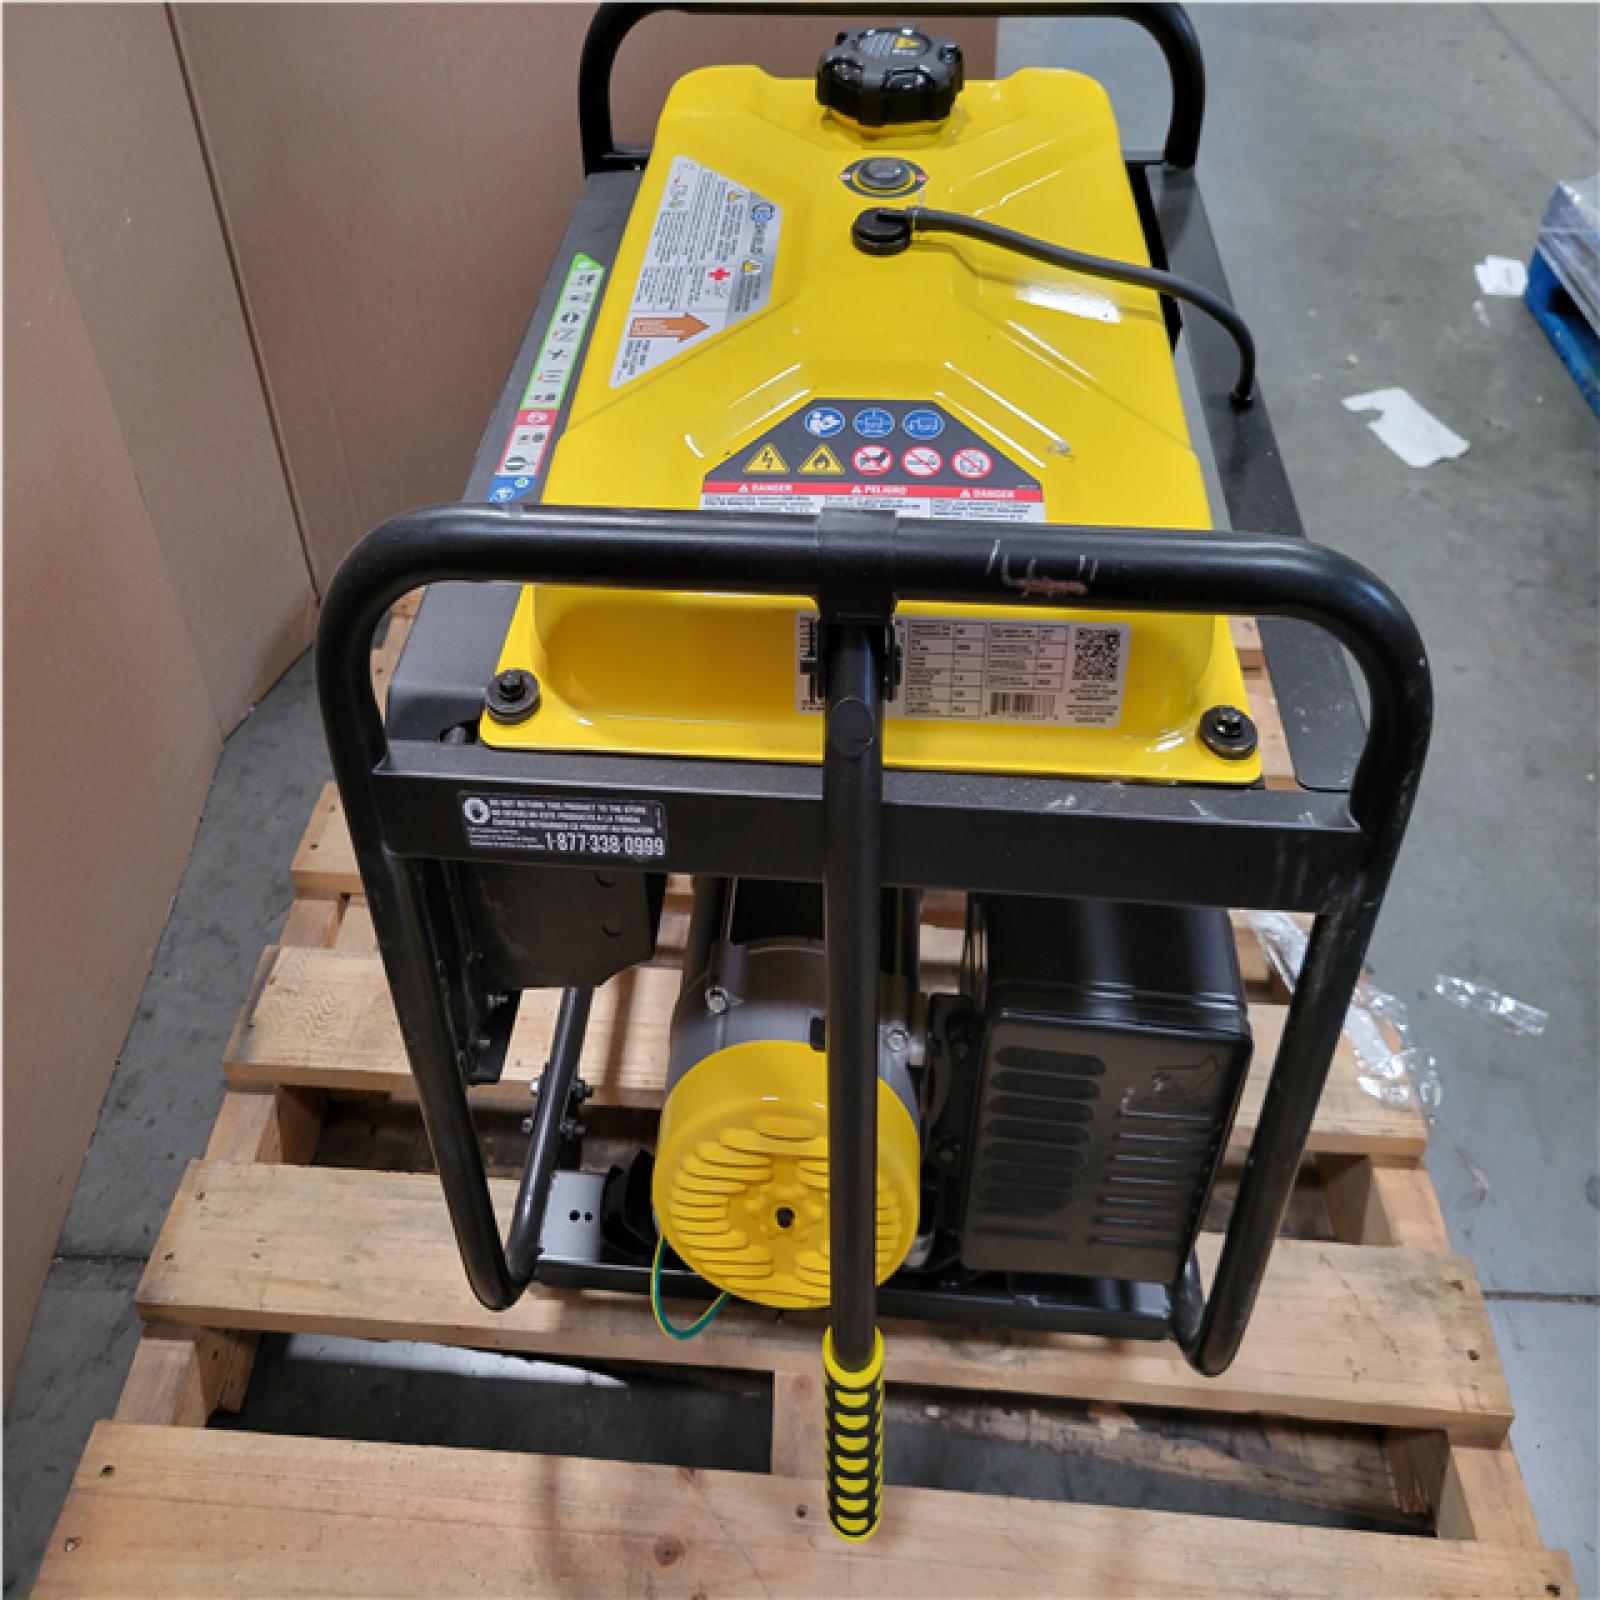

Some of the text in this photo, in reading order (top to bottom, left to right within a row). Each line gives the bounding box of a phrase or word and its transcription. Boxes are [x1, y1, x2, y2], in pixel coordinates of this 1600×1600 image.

[751, 483, 793, 493] DANGER
[864, 484, 908, 496] PELIGRO
[973, 489, 1016, 500] DANGER
[544, 831, 665, 857] 1-877-338-0999
